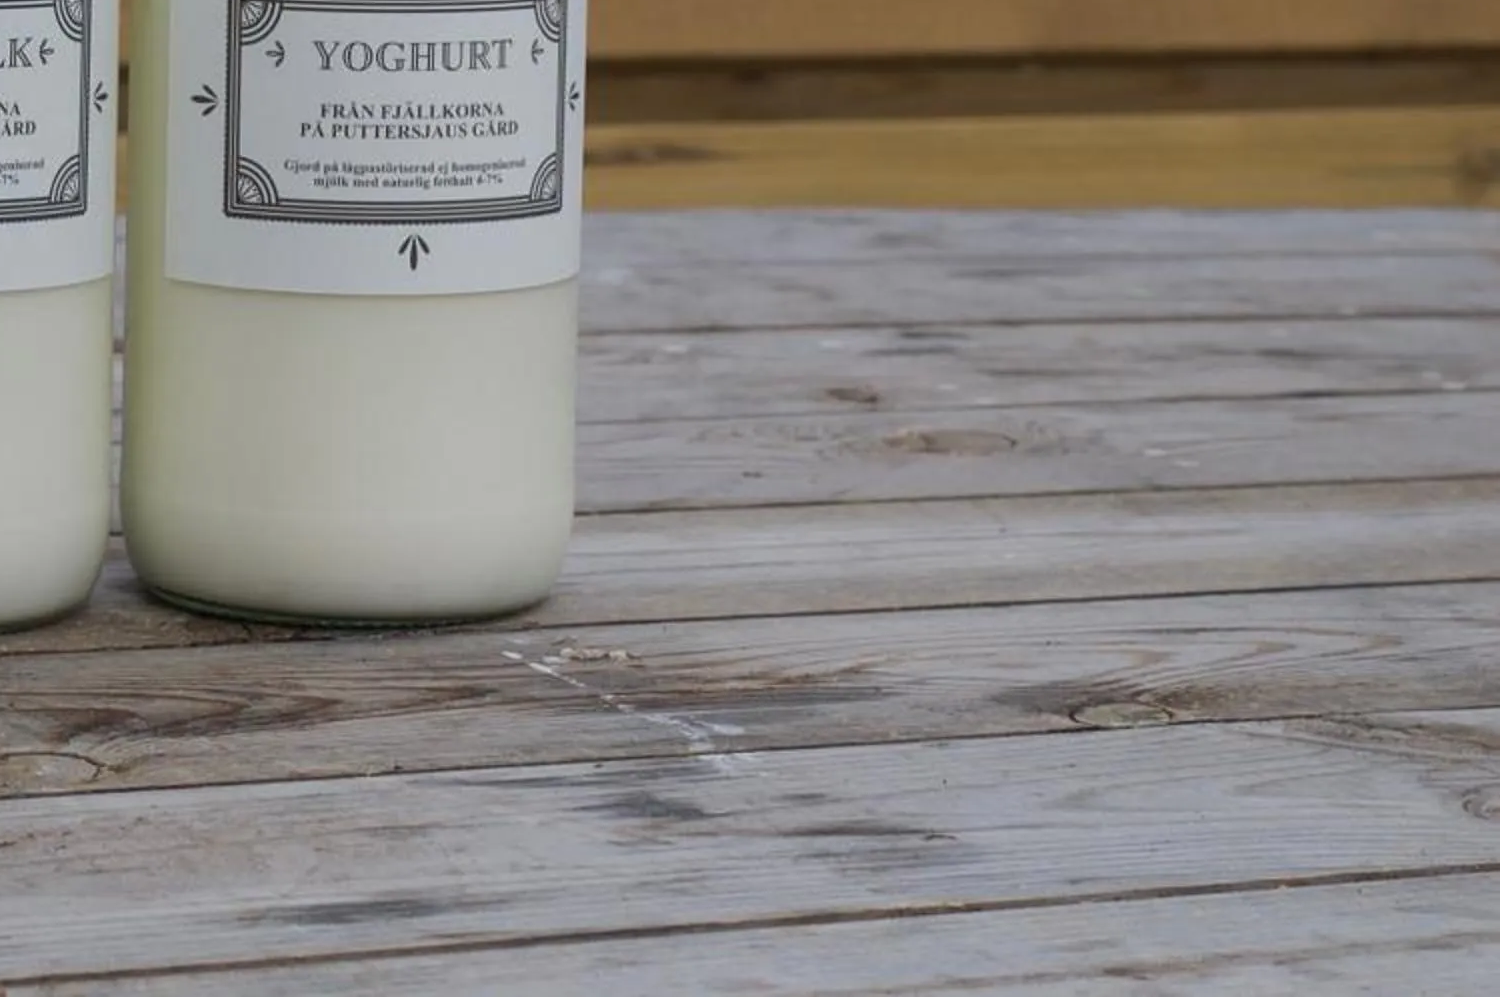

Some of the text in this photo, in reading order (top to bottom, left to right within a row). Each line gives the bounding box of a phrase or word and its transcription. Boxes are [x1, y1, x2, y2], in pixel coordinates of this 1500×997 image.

[313, 39, 513, 72] YOGHURT
[320, 101, 505, 121] FRÅN FJÄLLKORNA
[300, 120, 519, 140] PÅ PUTTERSJAUS GÅRD
[284, 159, 321, 174] Gjord
[323, 162, 340, 175] på
[437, 163, 449, 175] ej
[352, 176, 379, 188] med
